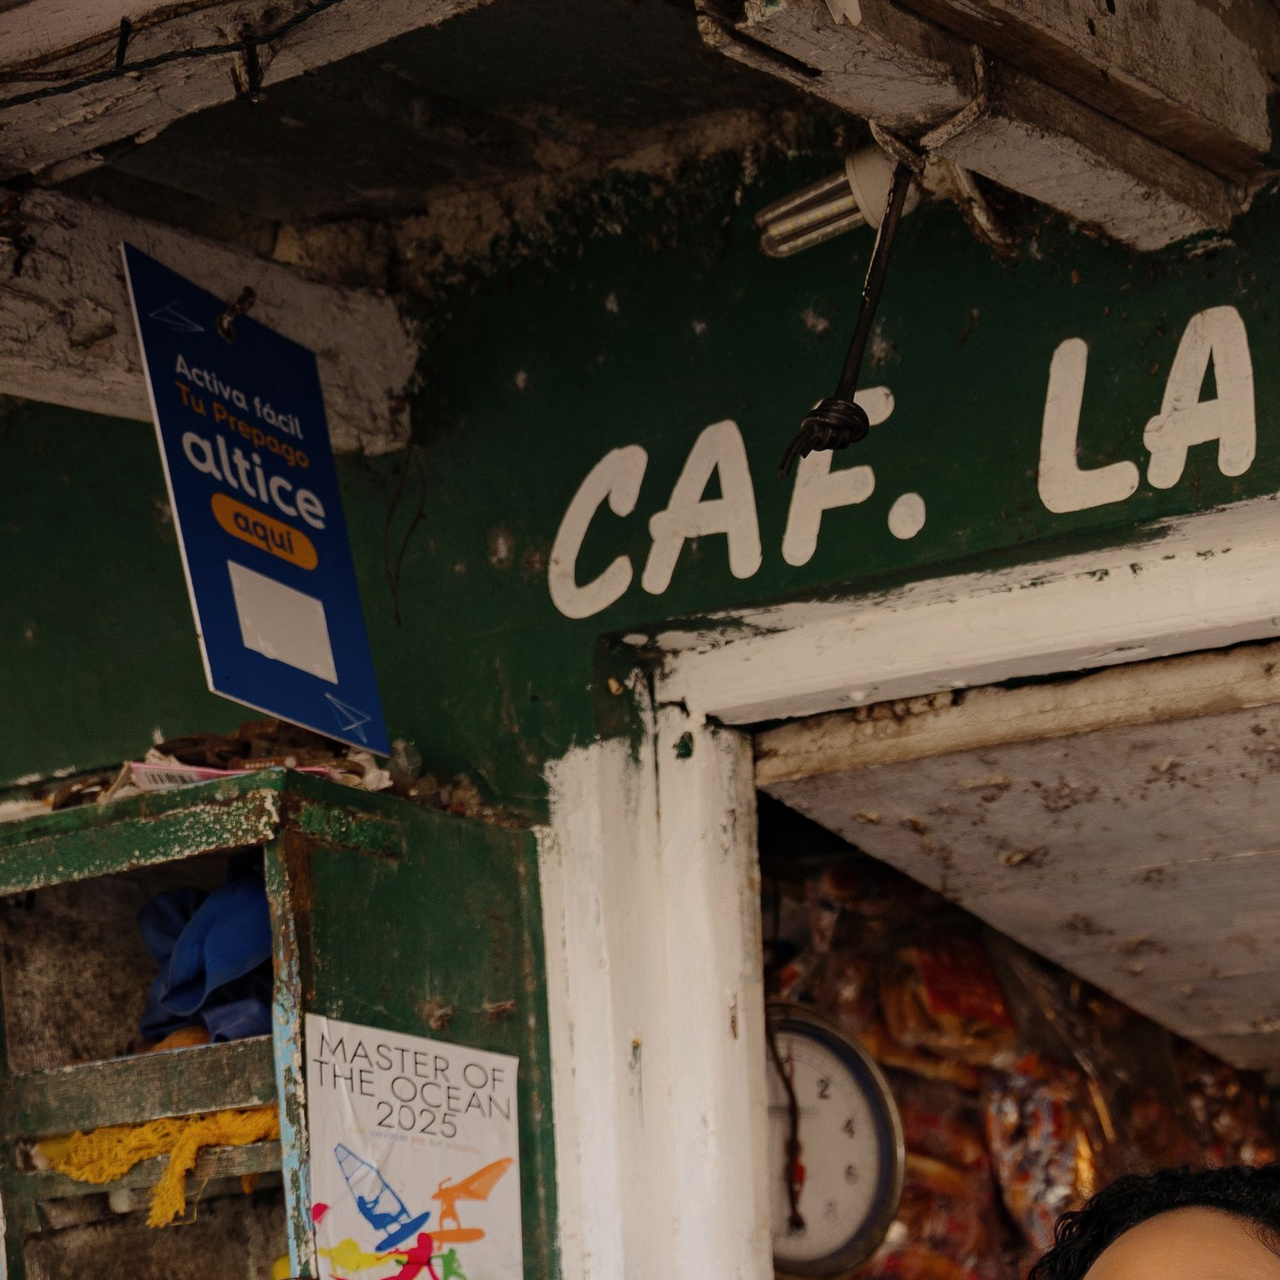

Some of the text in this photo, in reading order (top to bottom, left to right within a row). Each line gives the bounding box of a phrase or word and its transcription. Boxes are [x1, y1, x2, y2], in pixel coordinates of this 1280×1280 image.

[175, 354, 304, 440] Activa fácil
[175, 381, 310, 468] Tu Prepago
[181, 431, 326, 531] altice
[548, 386, 926, 619] CAF.
[1037, 305, 1256, 513] LA
[233, 511, 294, 556] aquí
[313, 1058, 511, 1120] THE OCEAN
[318, 1033, 505, 1092] MASTER OF
[817, 1078, 831, 1099] 2
[376, 1101, 458, 1139] 2025
